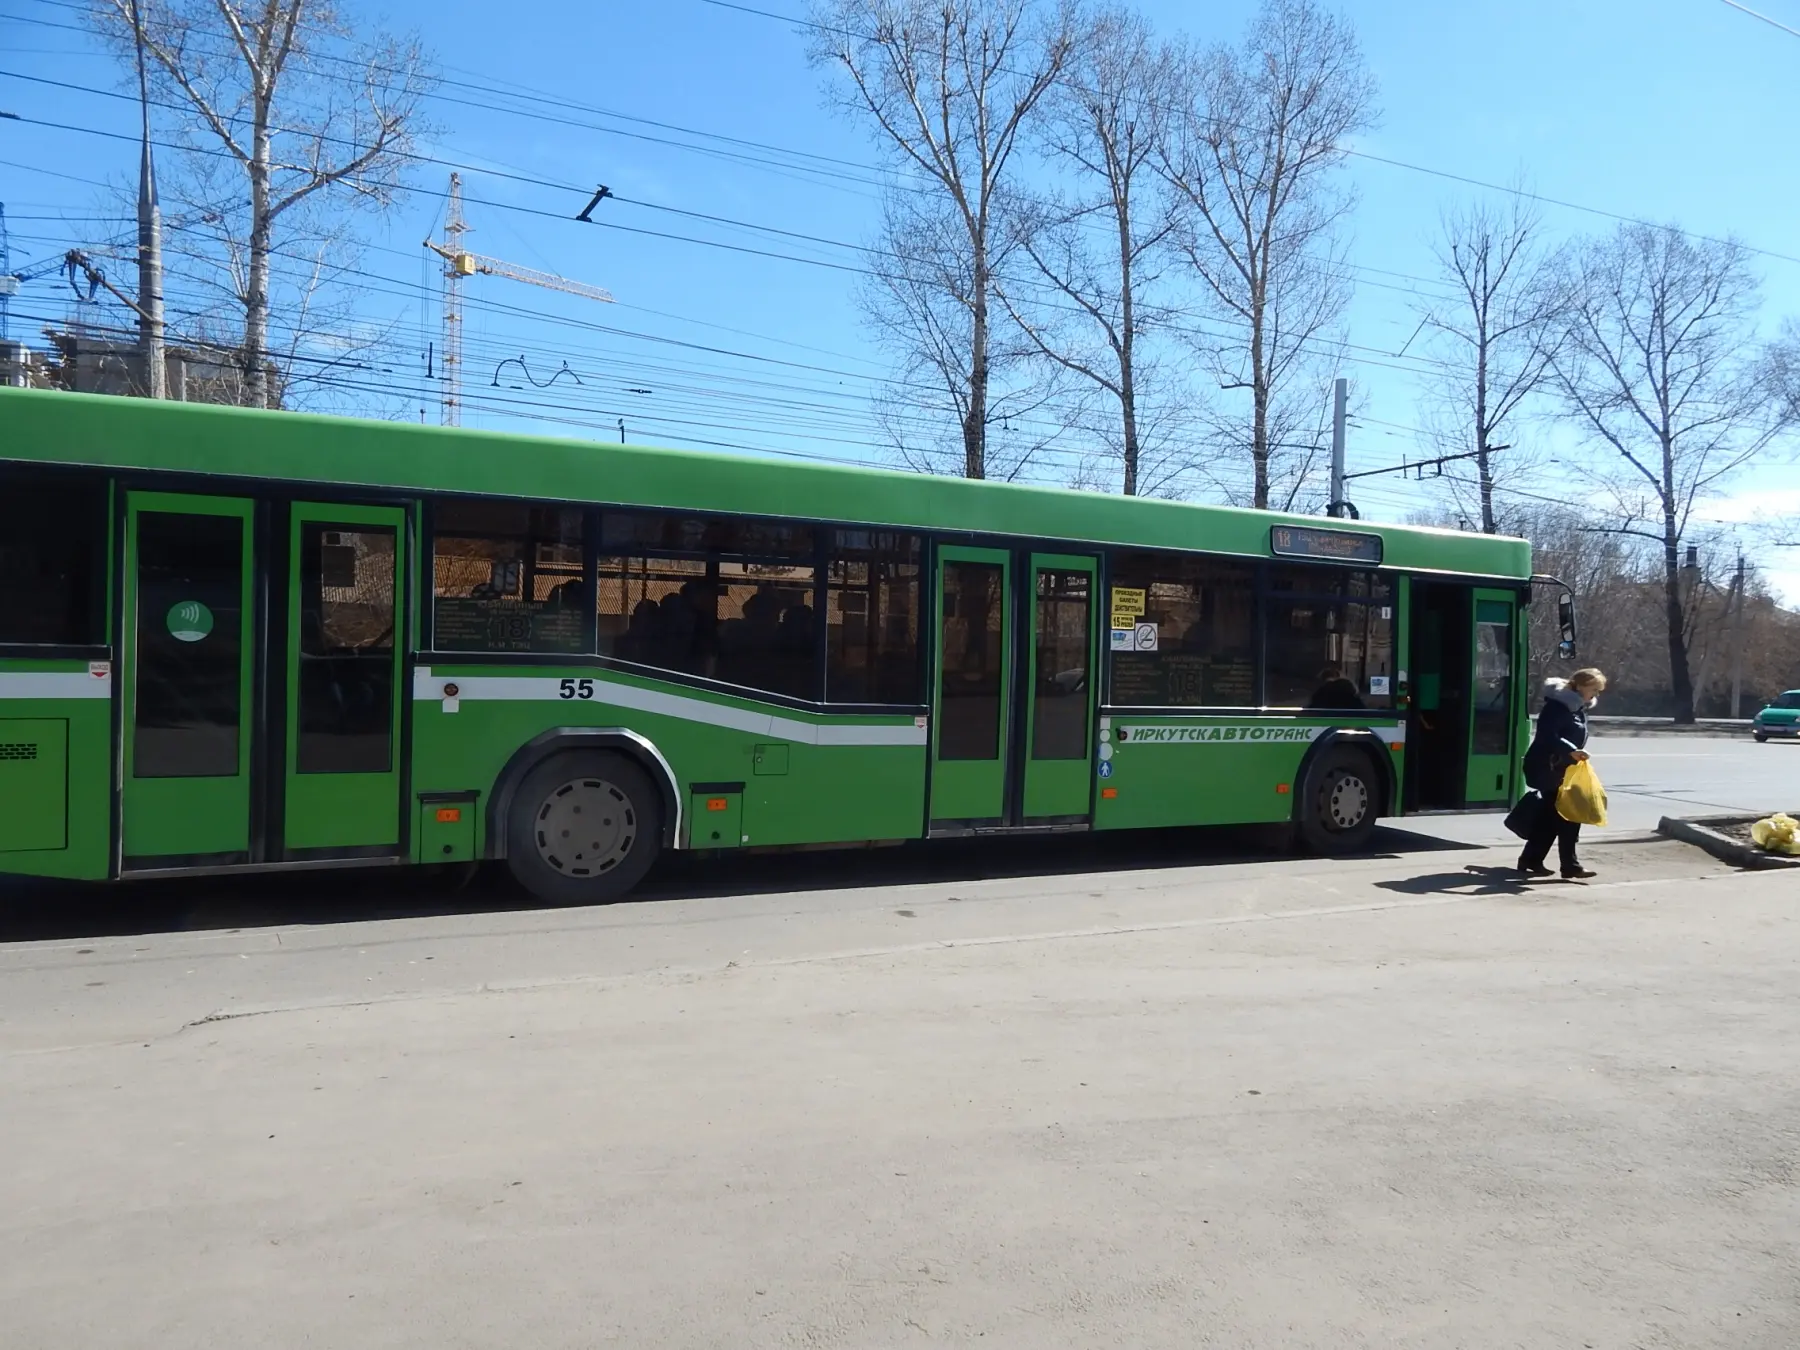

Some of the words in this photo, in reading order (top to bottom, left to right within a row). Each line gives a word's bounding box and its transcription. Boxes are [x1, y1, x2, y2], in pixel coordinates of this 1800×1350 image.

[1277, 530, 1291, 547] 18
[494, 616, 525, 640] 18
[1113, 616, 1121, 627] 15
[560, 678, 594, 700] 55
[1132, 727, 1313, 741] ИРКУТСКАВТОТРАНС
